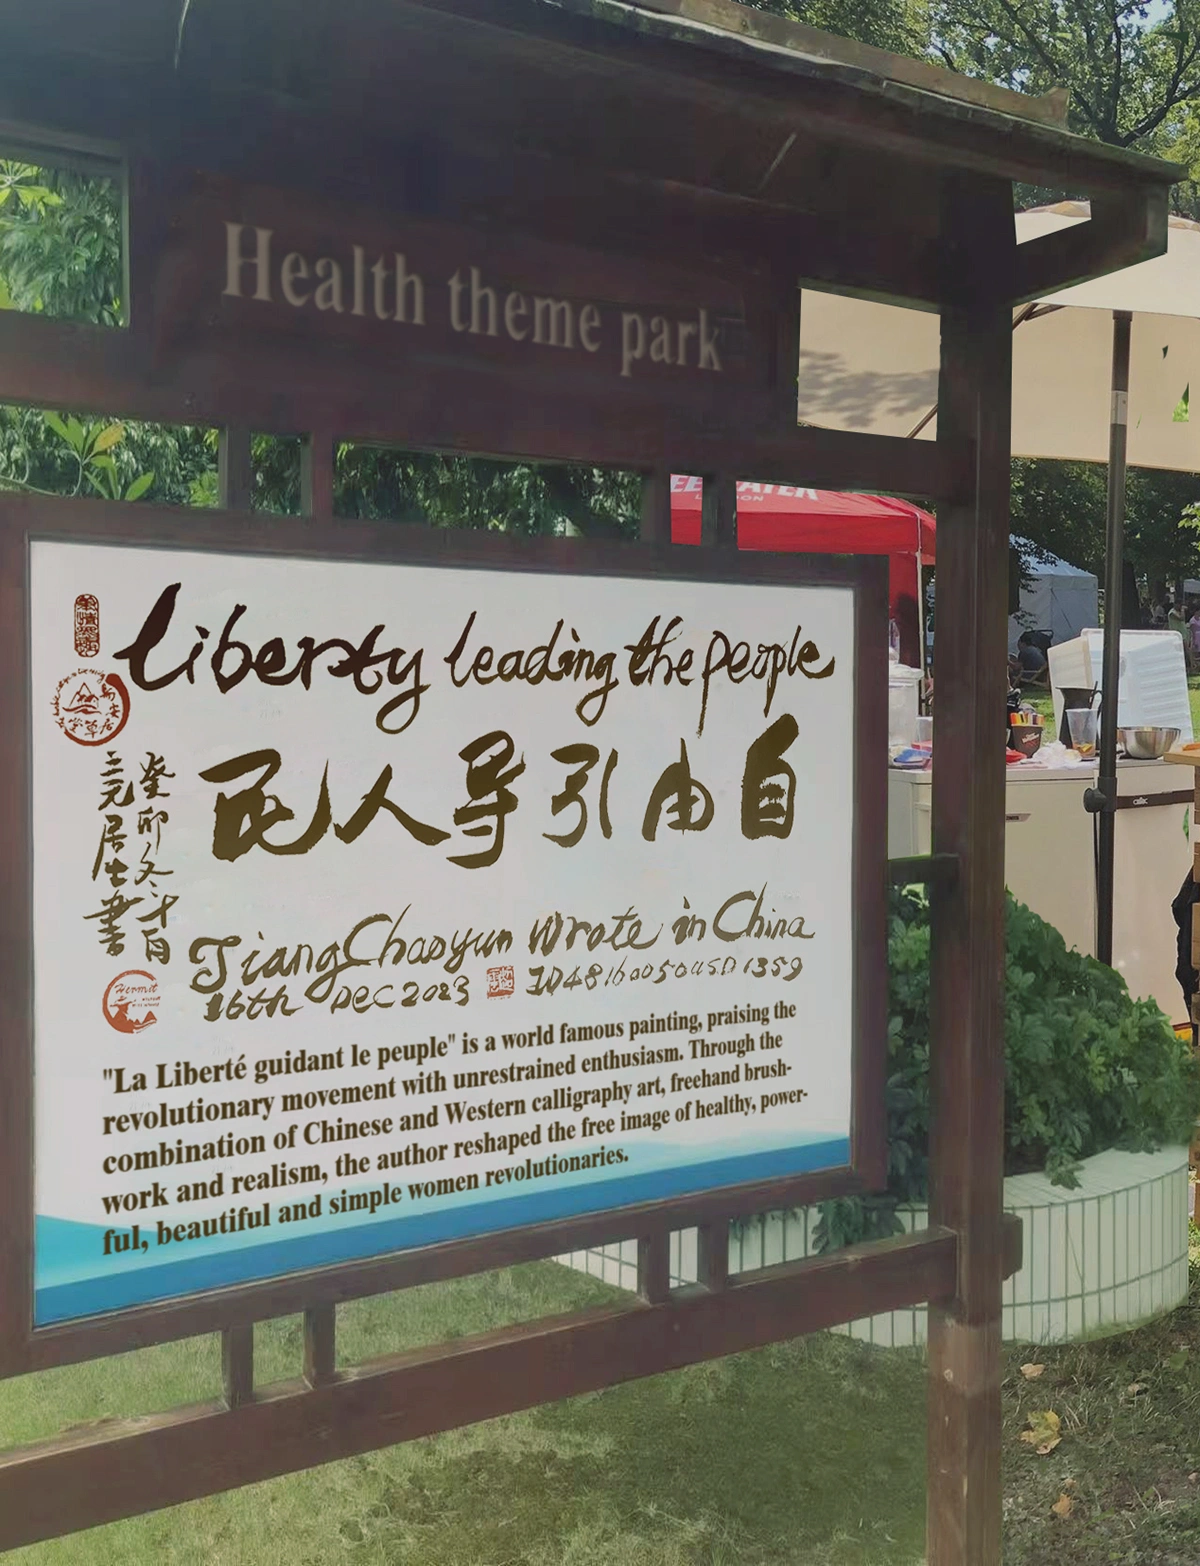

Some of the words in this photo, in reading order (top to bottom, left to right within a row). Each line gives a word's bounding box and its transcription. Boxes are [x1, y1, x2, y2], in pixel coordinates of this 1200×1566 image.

[222, 221, 426, 327] Health
[447, 266, 601, 352] theme
[620, 307, 723, 376] park
[444, 611, 620, 726] leading
[624, 615, 695, 686] the
[696, 625, 836, 738] people
[673, 896, 707, 942] in
[713, 882, 816, 942] China
[156, 1054, 247, 1089] Liberté
[254, 1047, 344, 1084] guidant
[351, 1044, 371, 1067] le
[462, 1032, 479, 1055] is
[485, 1036, 496, 1052] a
[501, 1024, 555, 1049] world
[560, 1022, 624, 1044] famous
[629, 1010, 703, 1041] painting,
[707, 1003, 770, 1033] praising
[774, 1000, 796, 1019] the
[204, 985, 304, 1022] 16th
[402, 975, 469, 1006] 2023
[103, 1097, 272, 1135] revolutionary
[281, 1077, 396, 1112] movement
[402, 1070, 447, 1096] with
[453, 1054, 576, 1090] unrestrained
[581, 1045, 684, 1073] enthusiasm.
[688, 1033, 755, 1059] Through
[759, 1031, 783, 1050] the
[103, 1132, 266, 1175] combination
[273, 1124, 298, 1150] of
[303, 1117, 393, 1145] Chinese
[399, 1105, 439, 1132] and
[444, 1099, 526, 1124] Western
[532, 1080, 630, 1112] calligraphy
[637, 1077, 666, 1097] art,
[670, 1064, 740, 1093] freehand
[744, 1058, 792, 1081] brush-
[102, 1182, 169, 1215] work
[176, 1172, 224, 1203] and
[232, 1162, 328, 1194] realism,
[335, 1153, 370, 1177] the
[377, 1142, 448, 1171] author
[454, 1124, 542, 1158] reshaped
[547, 1121, 576, 1143] the
[581, 1116, 615, 1138] free
[620, 1110, 670, 1131] image
[675, 1101, 693, 1122] of
[695, 1093, 756, 1119] healthy,
[760, 1089, 808, 1114] power-
[102, 1224, 149, 1256] ful,
[156, 1202, 271, 1246] beautiful
[278, 1194, 322, 1224] and
[329, 1182, 402, 1215] simple
[407, 1173, 479, 1200] women
[485, 1145, 629, 1187] revolutionaries.
